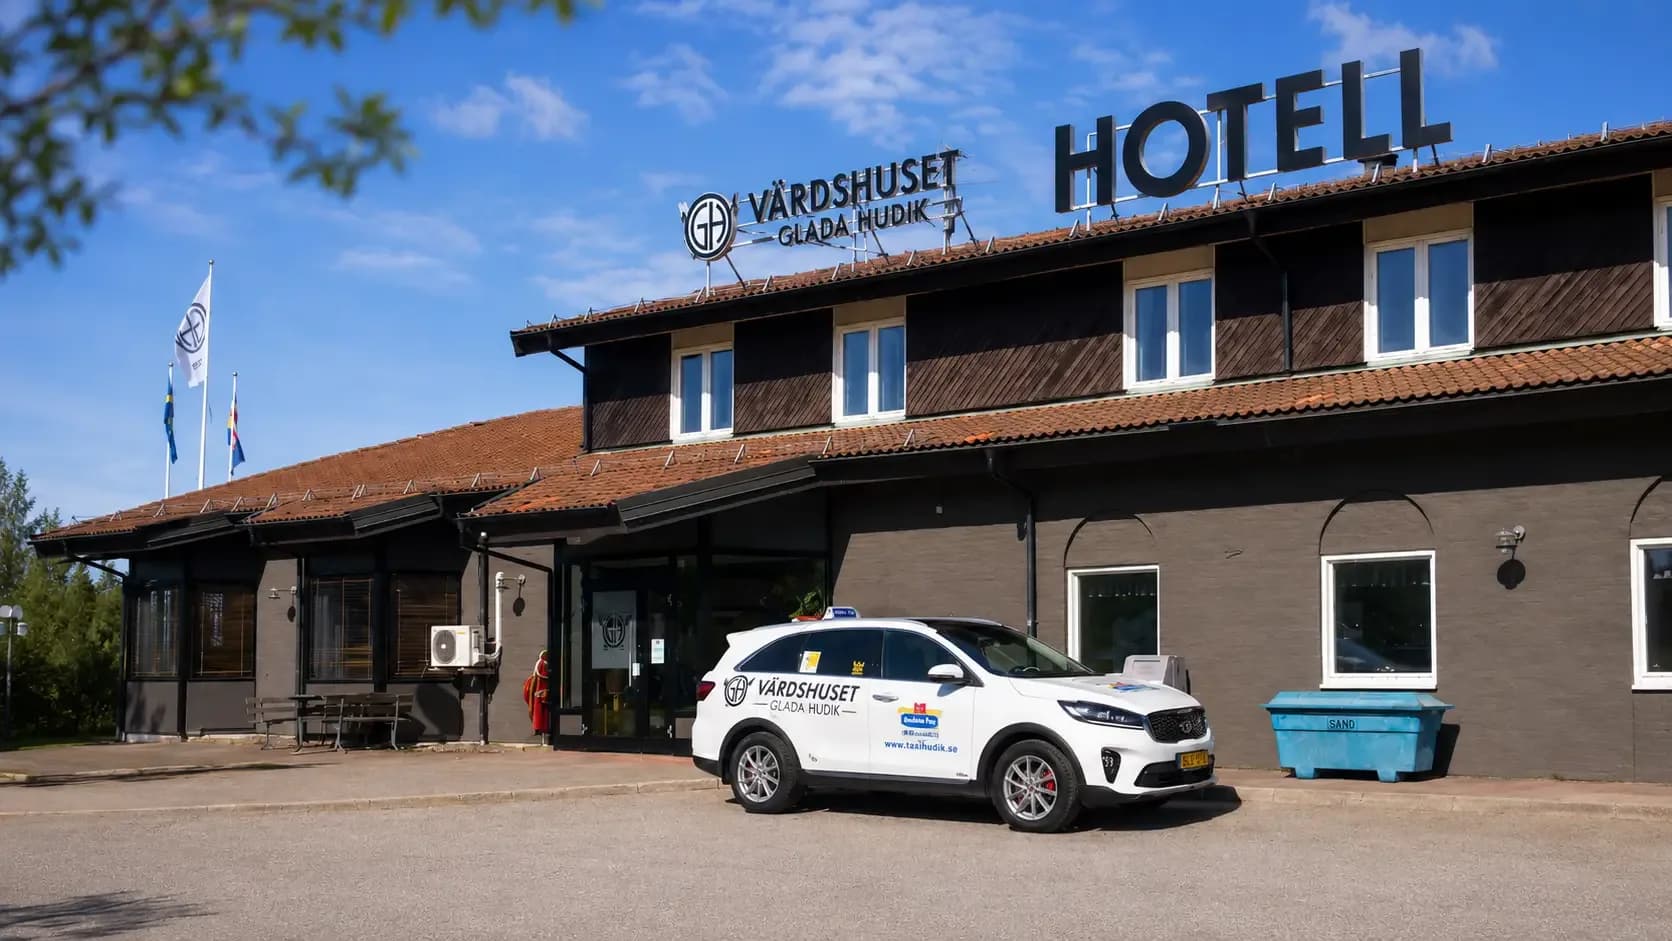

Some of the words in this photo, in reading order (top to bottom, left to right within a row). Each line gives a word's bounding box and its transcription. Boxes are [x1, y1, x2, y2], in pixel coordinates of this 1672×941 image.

[1055, 47, 1453, 213] HOTELL
[748, 149, 960, 224] VÄRDSHUSET
[778, 213, 850, 247] GLADA
[857, 197, 931, 232] HUDIK
[759, 677, 860, 702] VÄRDSHUSET
[770, 700, 805, 713] GLADA
[808, 702, 841, 716] HUDIK
[1329, 719, 1355, 729] SAND
